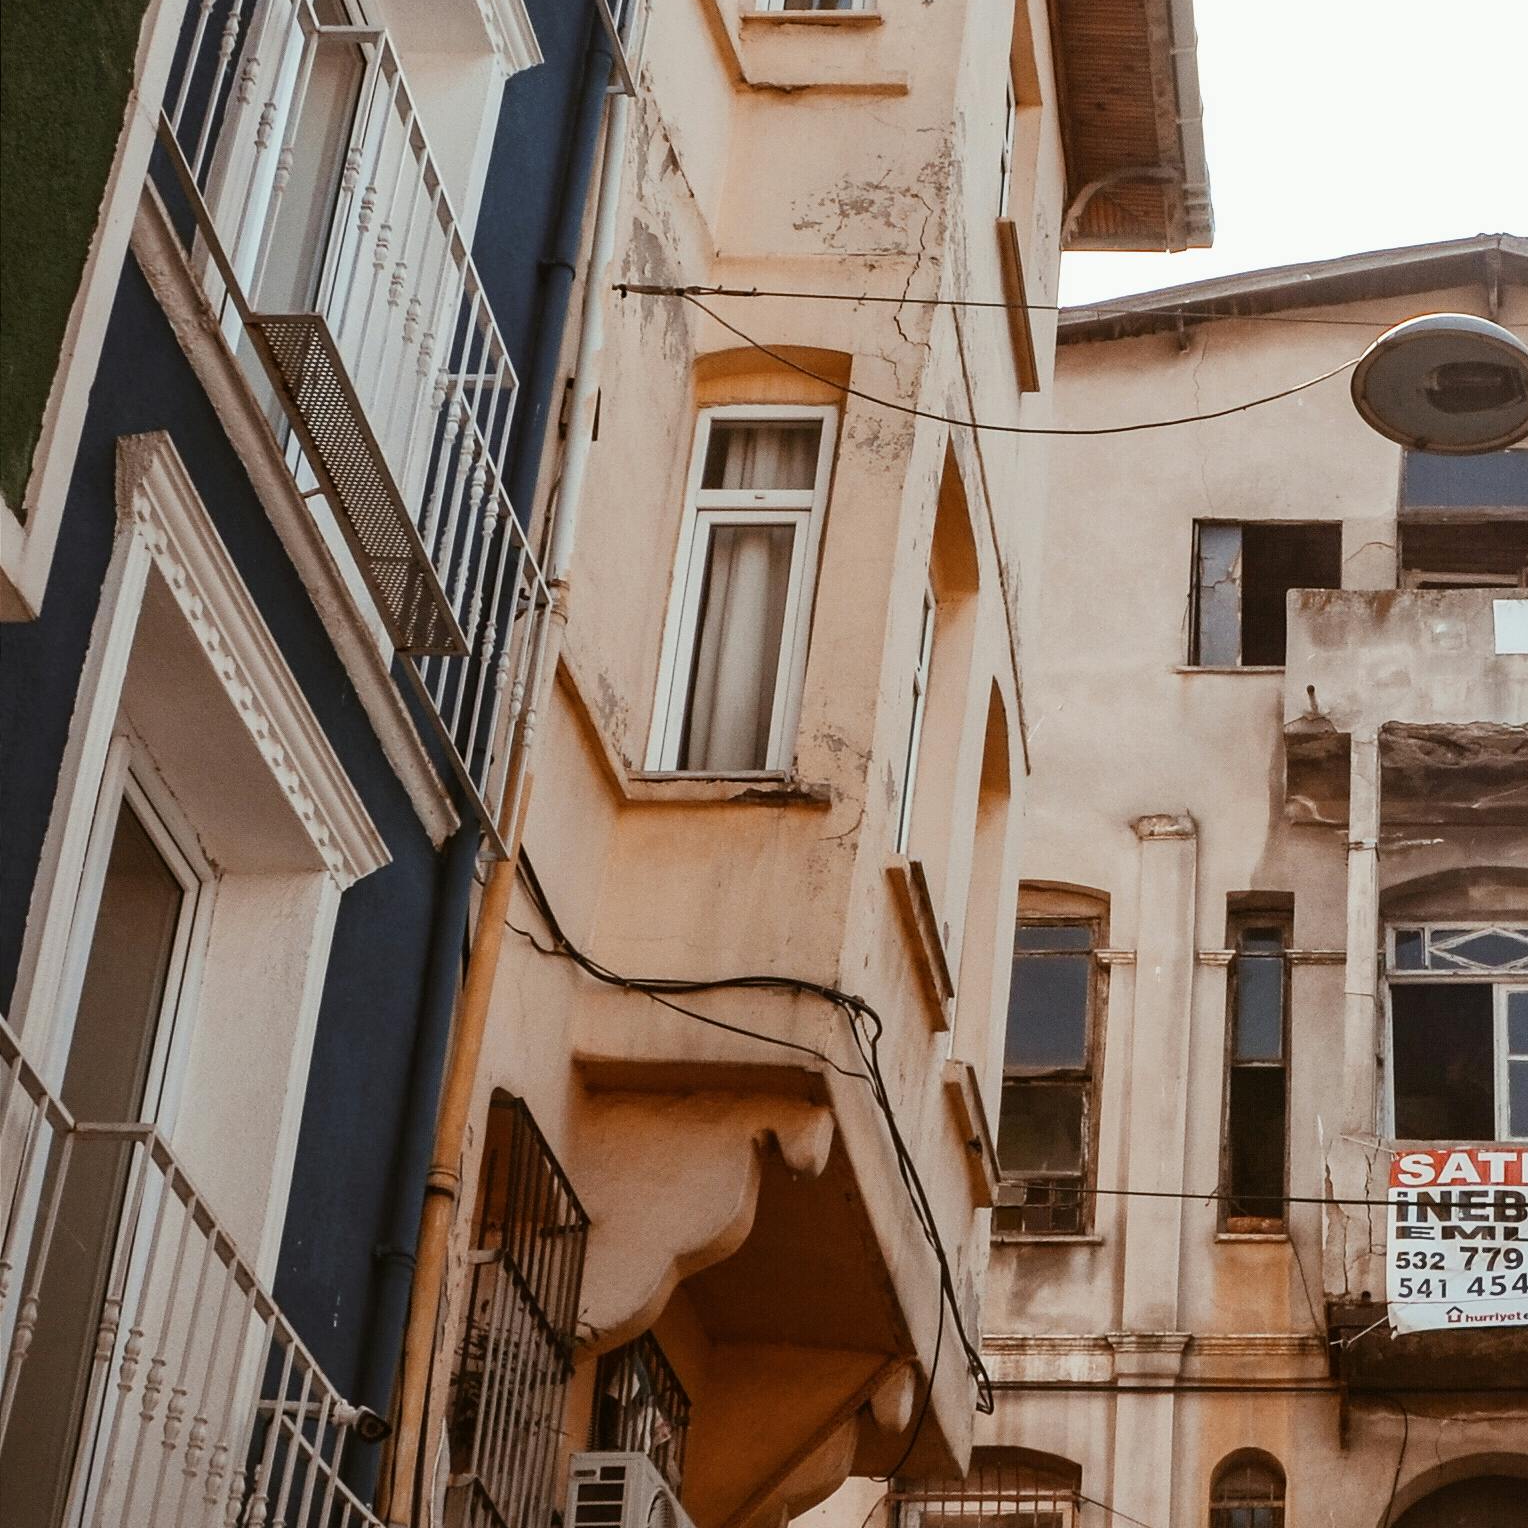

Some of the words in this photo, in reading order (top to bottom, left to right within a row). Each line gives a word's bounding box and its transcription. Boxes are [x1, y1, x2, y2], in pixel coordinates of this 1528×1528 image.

[1396, 1251, 1445, 1271] 532
[1460, 1246, 1524, 1271] 779
[1398, 1277, 1447, 1299] 541
